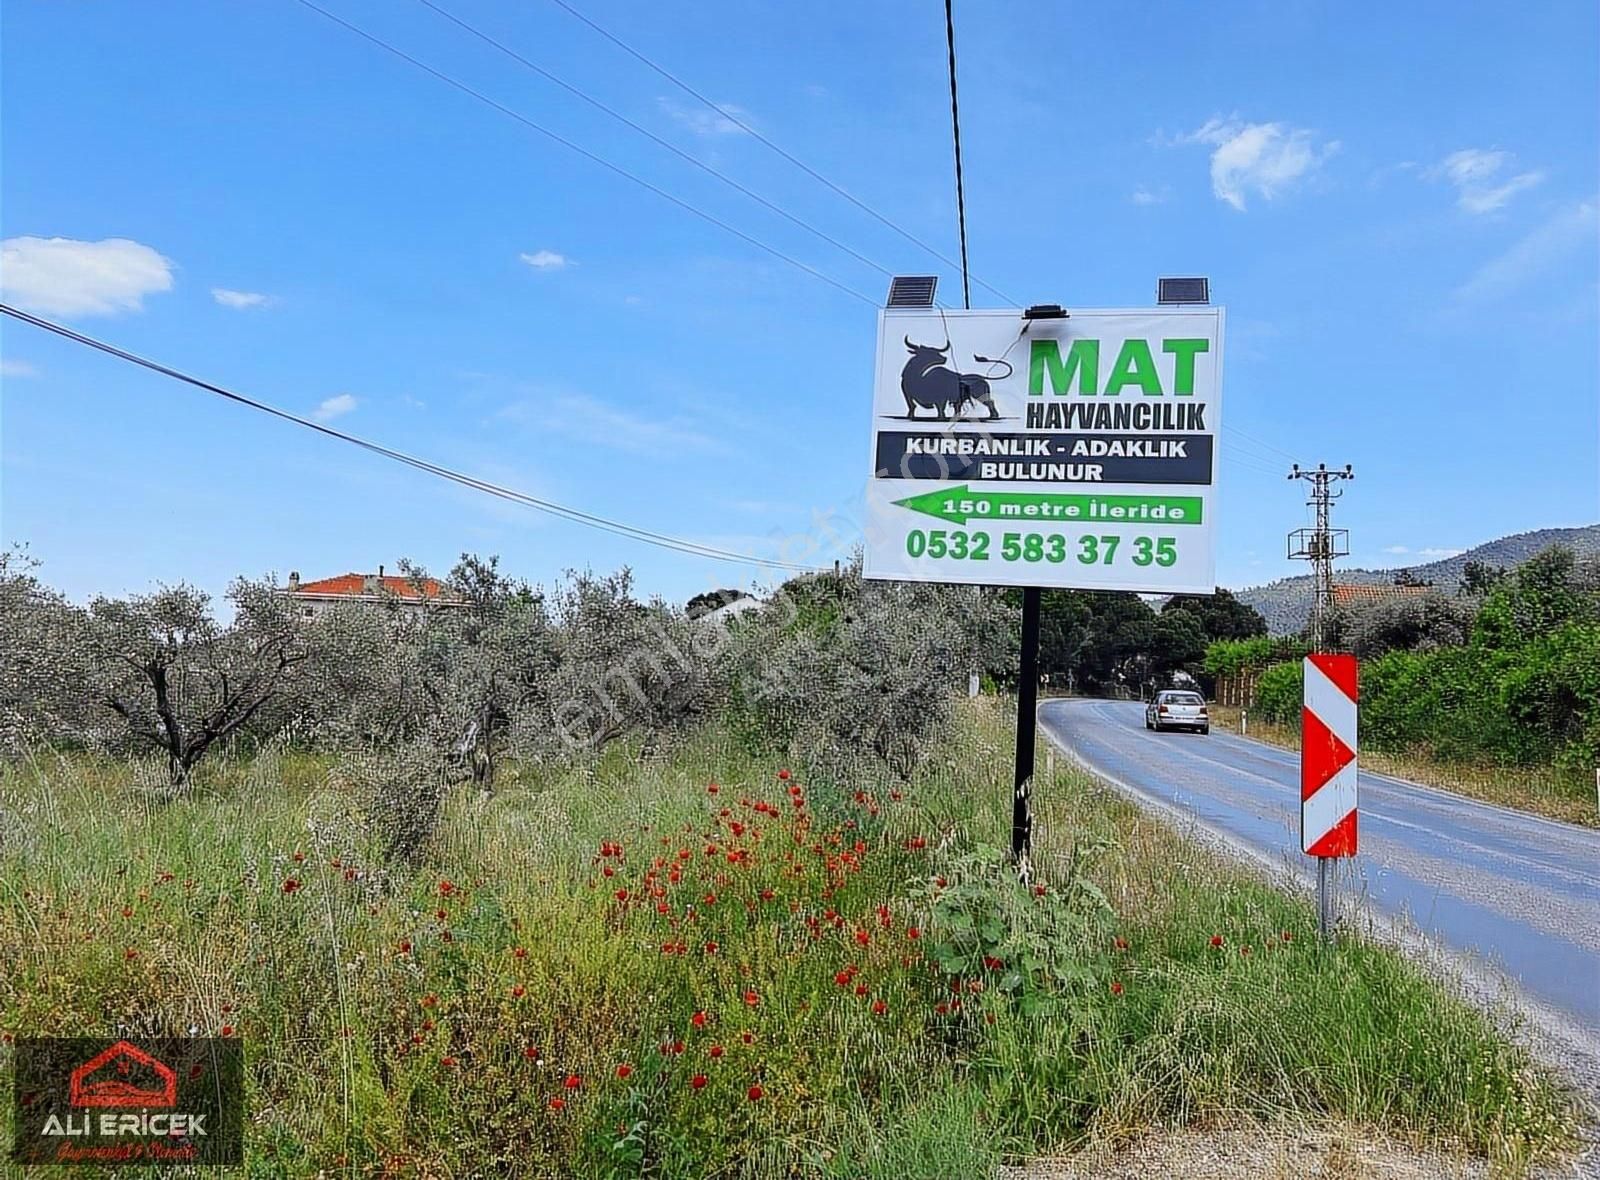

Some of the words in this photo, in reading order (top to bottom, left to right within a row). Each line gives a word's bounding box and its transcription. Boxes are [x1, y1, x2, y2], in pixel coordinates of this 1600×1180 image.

[1028, 338, 1210, 397] MAT
[1025, 402, 1207, 431] HAYVANCILIK
[905, 437, 1051, 458] KURBANLIK
[1070, 439, 1188, 459] ADAKLIK
[980, 462, 1104, 482] BULUNUR
[942, 498, 992, 515] 150
[999, 501, 1081, 519] metre
[1088, 498, 1186, 520] İleride
[906, 529, 991, 562] 0532
[1001, 531, 1067, 564] 583
[1076, 534, 1121, 566] 37
[1131, 536, 1178, 568] 35
